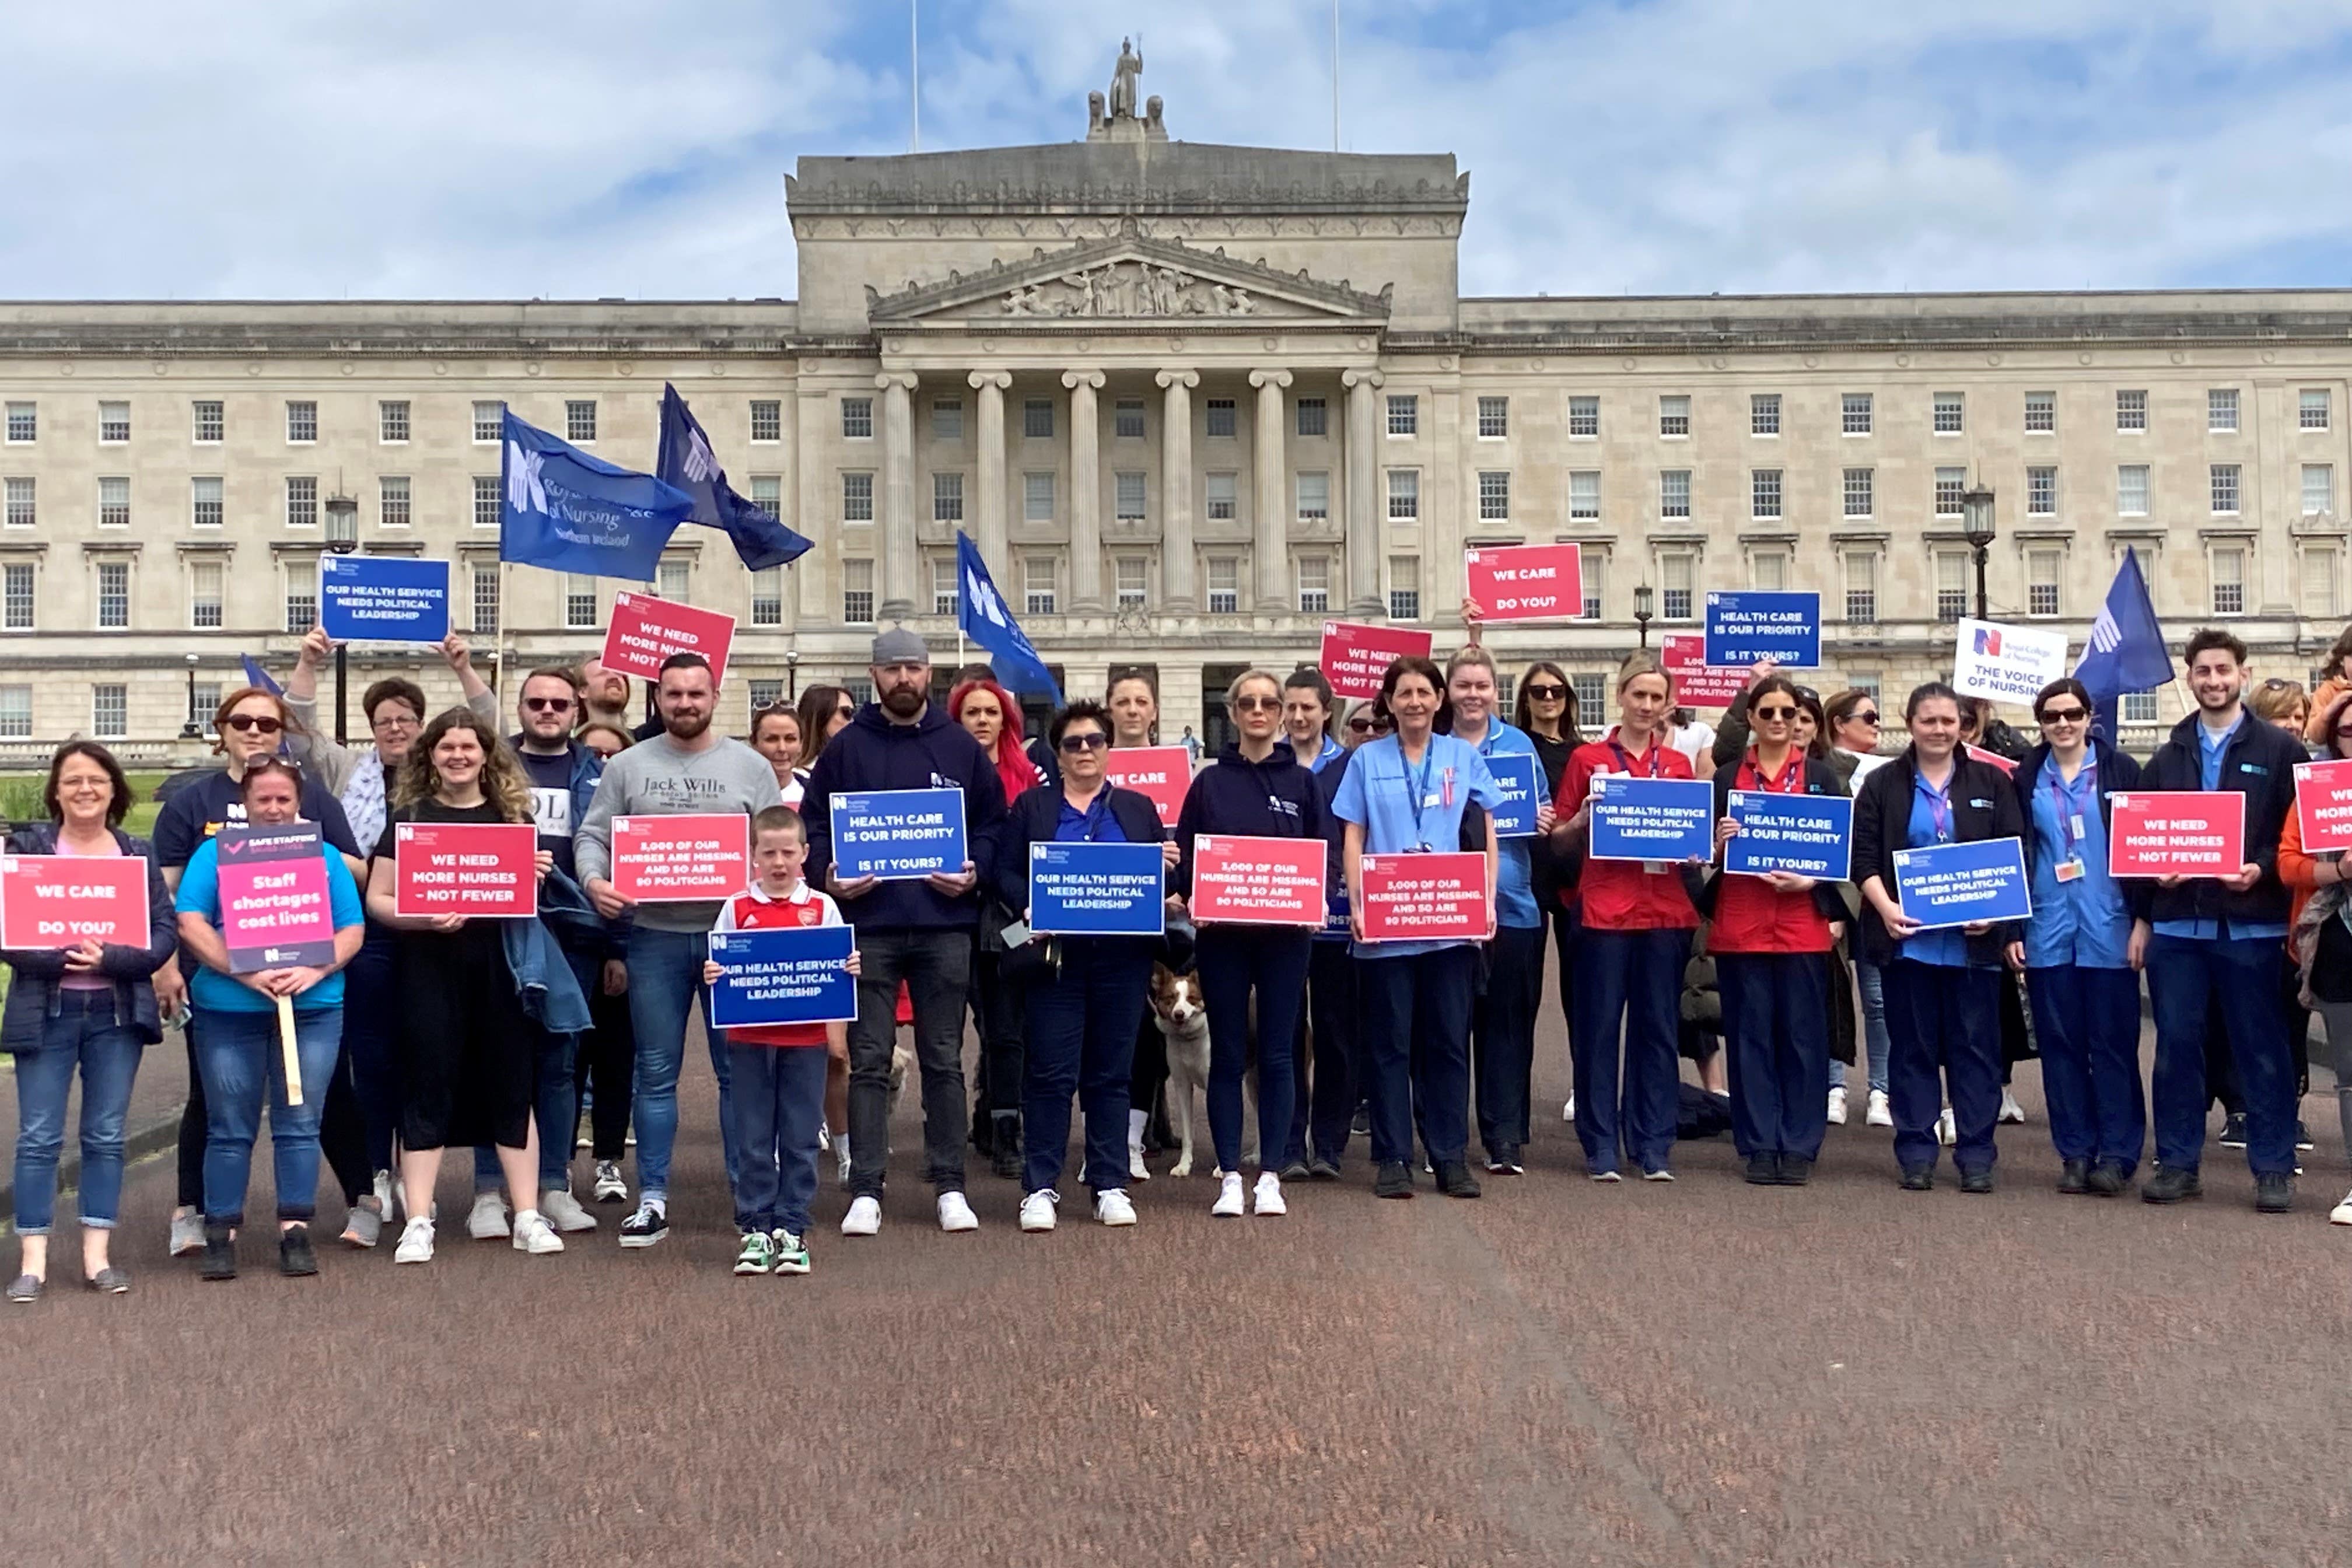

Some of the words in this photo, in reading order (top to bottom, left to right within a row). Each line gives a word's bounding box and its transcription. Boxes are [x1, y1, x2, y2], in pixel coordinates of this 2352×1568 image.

[562, 503, 620, 531] Nursing
[1493, 570, 1517, 582] WE
[1519, 568, 1557, 579] CARE
[326, 585, 350, 594] OUR
[352, 586, 395, 596] HEALTH
[397, 587, 443, 598] SERVICE
[337, 597, 373, 607] NEEDS
[375, 598, 432, 609] POLITICAL
[1496, 598, 1517, 610] DO
[1520, 596, 1557, 608] YOU?
[352, 610, 420, 620] LEADERSHIP
[1720, 612, 1768, 622] HEALTH
[1770, 612, 1803, 622] CARE
[640, 622, 662, 636] WE
[664, 628, 699, 645] NEED
[1714, 625, 1726, 635] IS
[1728, 625, 1754, 635] OUR
[1756, 625, 1811, 635] PRIORITY
[620, 634, 657, 652] MORE
[629, 652, 658, 667] NOT
[1349, 648, 1368, 660] WE
[1725, 650, 1736, 660] IS
[1739, 651, 1750, 660] IT
[1752, 651, 1800, 661] YOURS?
[1332, 660, 1366, 673] MORE
[1975, 664, 2000, 677] THE
[2004, 670, 2044, 685] VOICE
[1342, 676, 1368, 688] NOT
[1723, 679, 1742, 687] ARE
[1968, 677, 1986, 687] OF
[1990, 680, 2039, 696] NURSIN
[1128, 772, 1167, 785] CARE
[640, 778, 677, 797] Jack
[683, 778, 726, 793] Wills
[1596, 806, 1618, 814] OUR
[1620, 806, 1661, 815] HEALTH
[1663, 807, 1706, 818] SERVICE
[850, 814, 903, 828] HEALTH
[907, 813, 944, 825] CARE
[1606, 817, 1640, 827] NEEDS
[1643, 818, 1696, 829] POLITICAL
[1744, 814, 1794, 827] HEALTH
[1797, 818, 1832, 830] CARE
[2143, 820, 2168, 830] WE
[2170, 820, 2208, 830] NEED
[844, 831, 856, 843] IS
[859, 830, 888, 842] OUR
[892, 827, 954, 841] PRIORITY
[1620, 828, 1684, 839] LEADERSHIP
[1752, 828, 1779, 840] OUR
[1782, 831, 1842, 845] PRIORITY
[249, 838, 271, 846] SAFE
[274, 834, 317, 844] STAFFING
[676, 841, 692, 850] OF
[695, 840, 720, 849] OUR
[2126, 836, 2166, 846] MORE
[2169, 836, 2224, 846] NURSES
[431, 855, 456, 866] WE
[459, 855, 499, 866] NEED
[620, 853, 665, 863] NURSES
[667, 853, 691, 862] ARE
[693, 852, 743, 862] MISSING.
[1747, 855, 1760, 866] IS
[1762, 856, 1774, 867] IT
[1777, 858, 1828, 872] YOURS?
[2138, 852, 2169, 863] NOT
[2171, 852, 2221, 863] FEWER
[645, 865, 670, 874] AND
[673, 864, 690, 874] SO
[691, 864, 715, 873] ARE
[858, 860, 871, 872] IS
[875, 859, 886, 871] IT
[890, 857, 943, 870] YOURS?
[1255, 863, 1272, 873] OF
[1273, 864, 1298, 873] OUR
[253, 873, 296, 890] Staff
[412, 872, 455, 883] MORE
[459, 873, 517, 884] NURSES
[654, 876, 726, 886] POLITICIANS
[1035, 874, 1060, 884] OUR
[1063, 875, 1106, 884] HEALTH
[1109, 876, 1156, 885] SERVICE
[1200, 873, 1244, 883] NURSES
[1247, 875, 1270, 884] ARE
[1271, 876, 1320, 887] MISSING.
[1902, 876, 1926, 887] OUR
[1928, 871, 1971, 884] HEALTH
[1972, 866, 2017, 878] SERVICE
[1420, 880, 1435, 890] OF
[1437, 879, 1461, 888] OUR
[1915, 884, 1950, 896] NEEDS
[1952, 878, 2008, 892] POLITICAL
[35, 885, 65, 898] WE
[69, 886, 116, 898] CARE
[427, 890, 459, 901] NOT
[462, 890, 514, 902] FEWER
[1047, 887, 1084, 896] NEEDS
[1087, 887, 1144, 897] POLITICAL
[1224, 886, 1250, 895] AND
[1251, 887, 1267, 896] SO
[1269, 887, 1292, 897] ARE
[1368, 892, 1410, 903] NURSES
[1412, 891, 1434, 901] ARE
[1436, 890, 1483, 900] MISSING.
[1931, 890, 1997, 905] LEADERSHIP
[233, 892, 321, 910] shortages
[1063, 899, 1132, 908] LEADERSHIP
[1216, 897, 1231, 906] 90
[1233, 898, 1303, 909] POLITICIANS
[1392, 904, 1415, 914] AND
[1418, 904, 1433, 912] SO
[1436, 903, 1457, 912] ARE
[238, 914, 275, 929] cost
[279, 911, 319, 926] lives
[1402, 915, 1468, 925] POLITICIANS
[38, 921, 65, 935] DO
[69, 921, 116, 935] YOU?
[746, 961, 794, 974] HEALTH
[796, 958, 846, 971] SERVICE
[729, 976, 769, 988] NEEDS
[772, 972, 835, 986] POLITICAL
[747, 986, 822, 1000] LEADERSHIP
